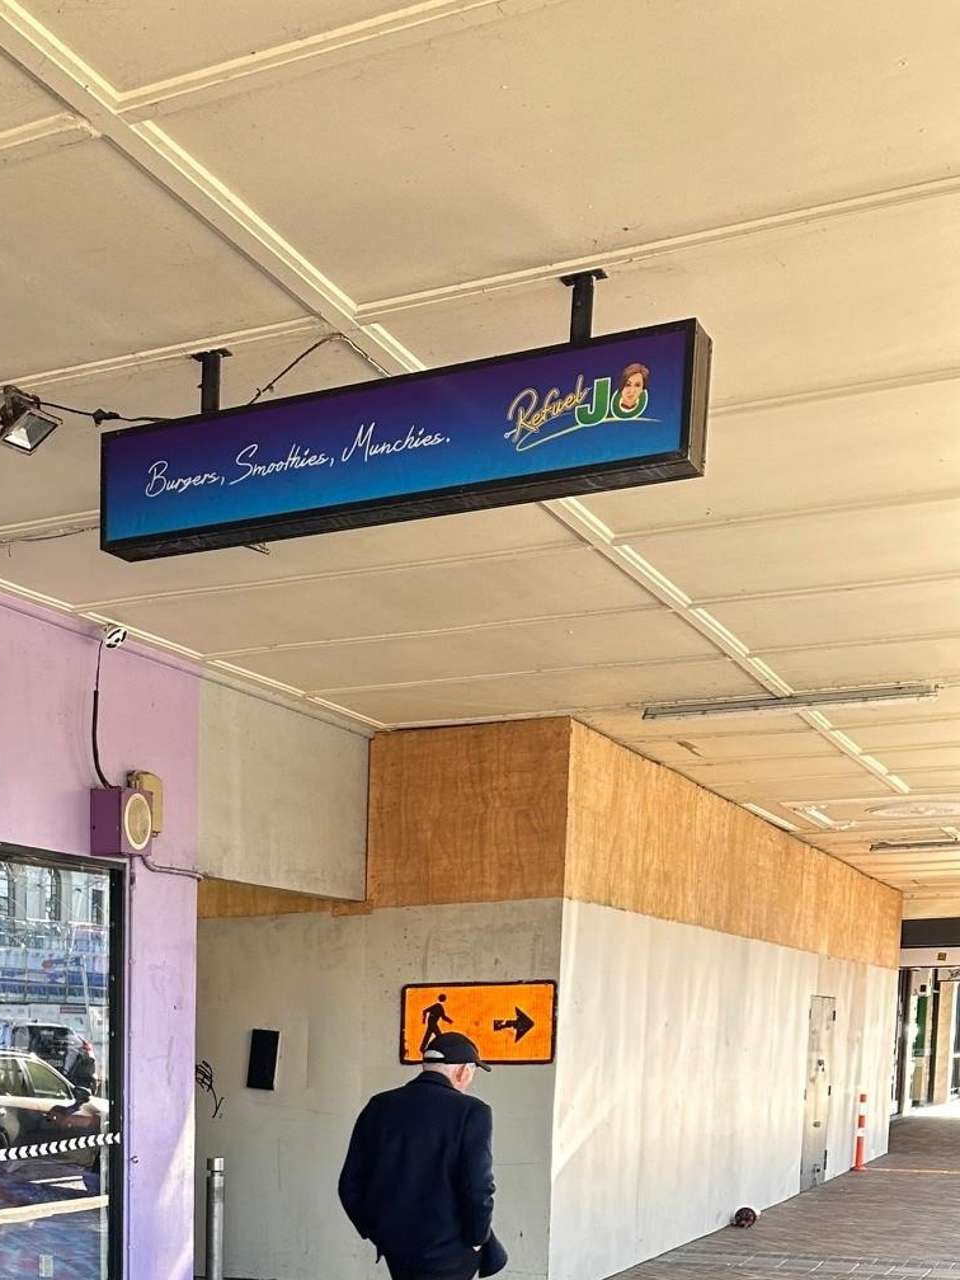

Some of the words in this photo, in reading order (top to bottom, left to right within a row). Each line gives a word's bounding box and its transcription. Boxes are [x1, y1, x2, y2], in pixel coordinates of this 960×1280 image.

[506, 374, 591, 443] Refuel
[145, 460, 225, 497] Burgers,
[229, 443, 333, 485] Smoothies,
[341, 421, 451, 463] Munchies.
